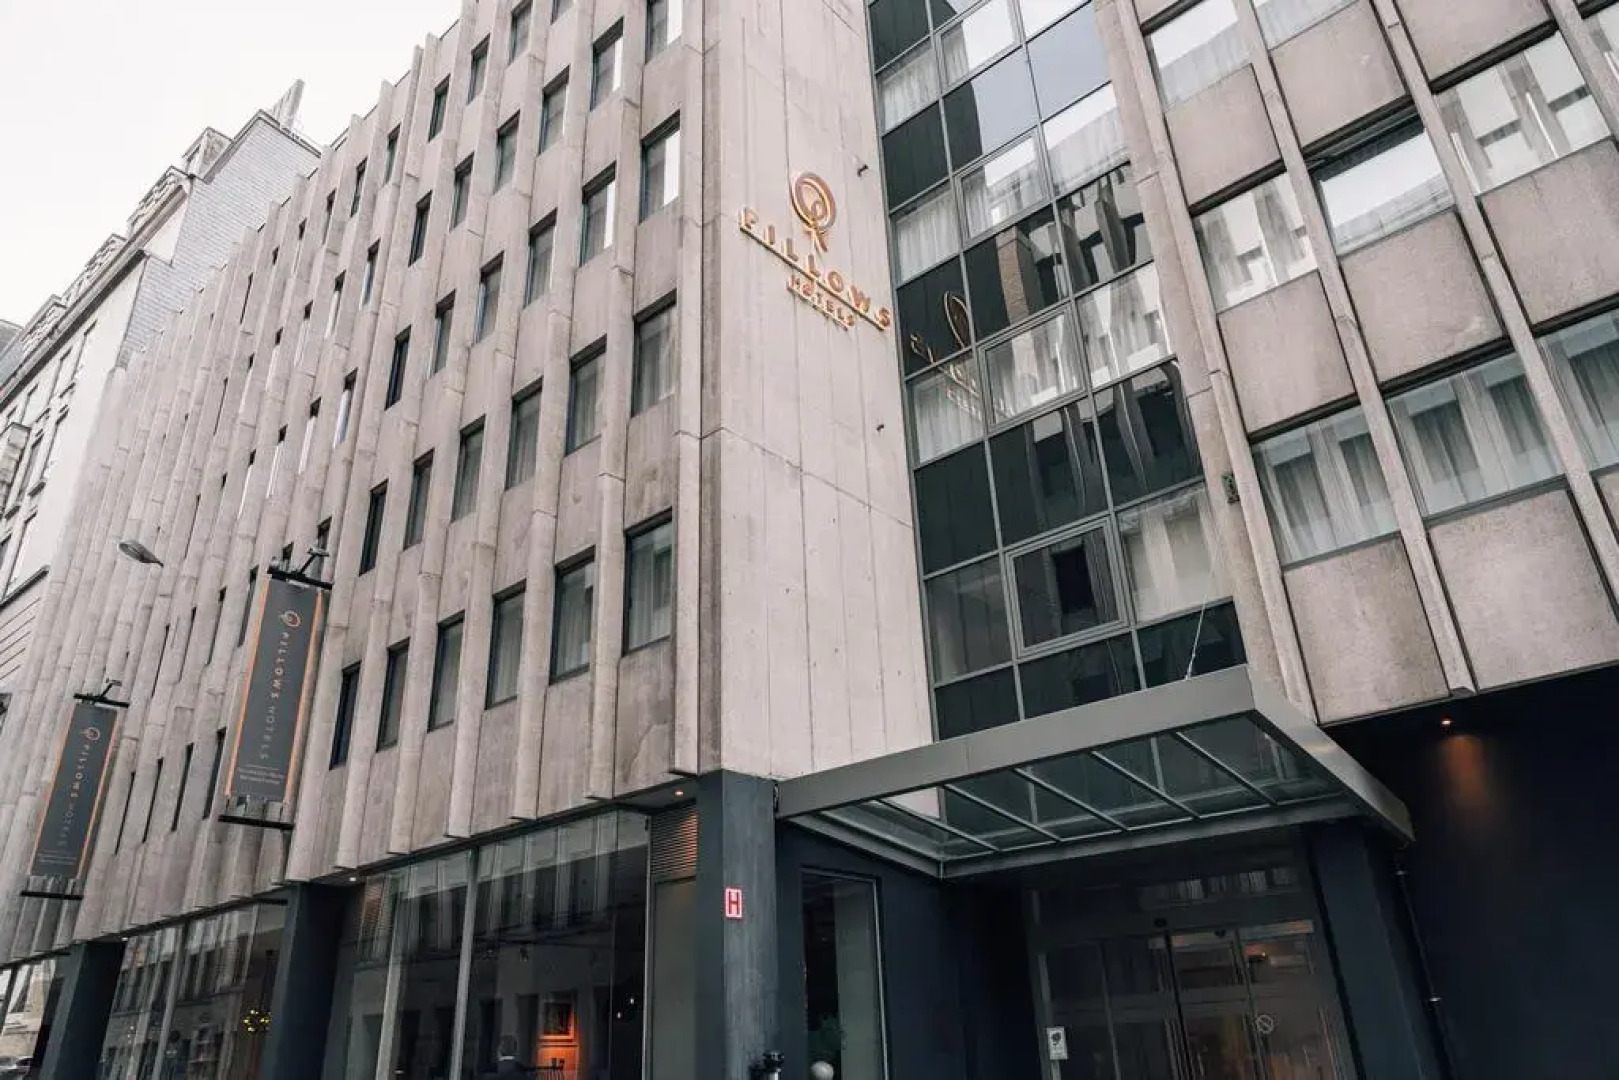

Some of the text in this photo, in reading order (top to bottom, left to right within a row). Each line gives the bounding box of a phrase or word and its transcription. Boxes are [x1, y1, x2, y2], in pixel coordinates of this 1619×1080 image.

[738, 207, 891, 328] PILLOWS
[786, 274, 856, 328] HOTELS
[728, 891, 740, 915] H
